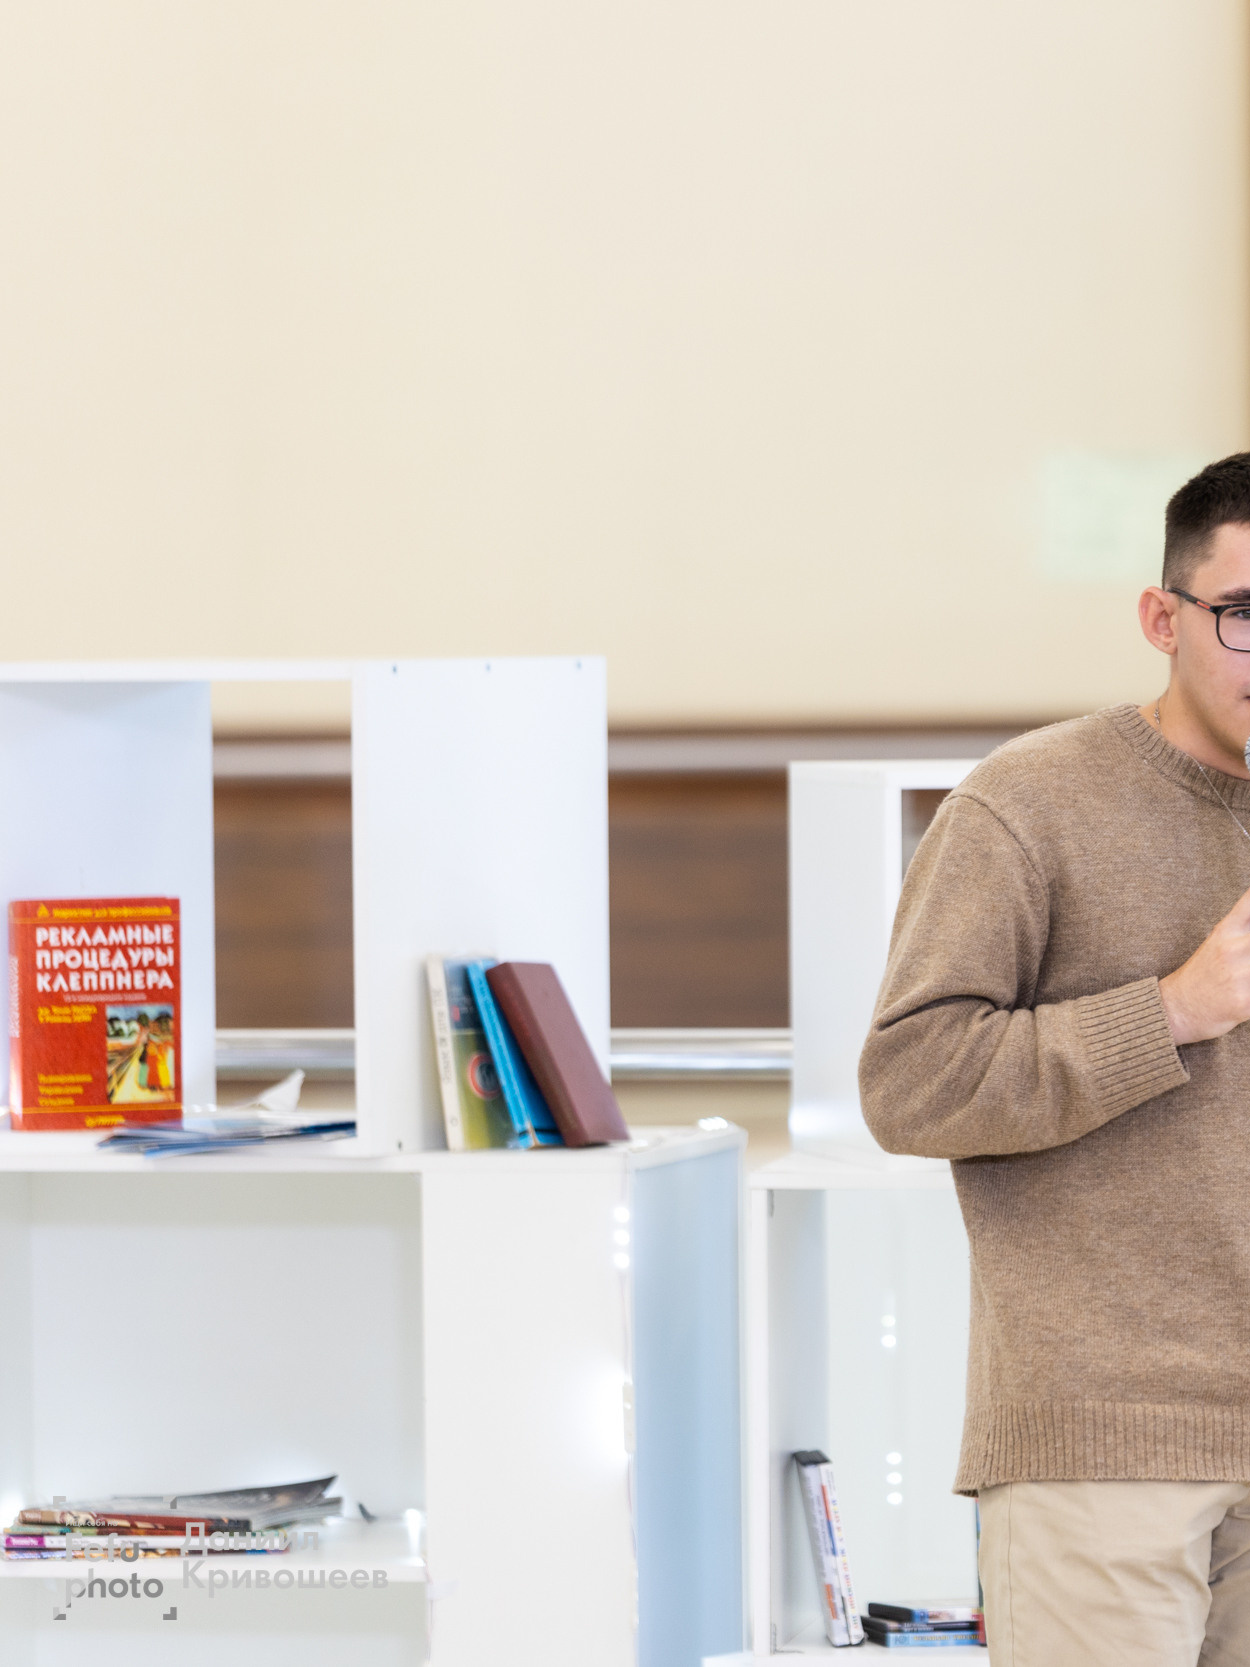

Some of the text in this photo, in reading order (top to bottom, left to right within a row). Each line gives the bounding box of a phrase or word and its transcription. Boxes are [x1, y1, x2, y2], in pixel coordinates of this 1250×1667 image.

[36, 924, 174, 948] РЕКЛАМНЫЕ
[36, 946, 174, 971] ПРОЦЕДУРЫ
[36, 969, 174, 992] КЛЕППНЕРА
